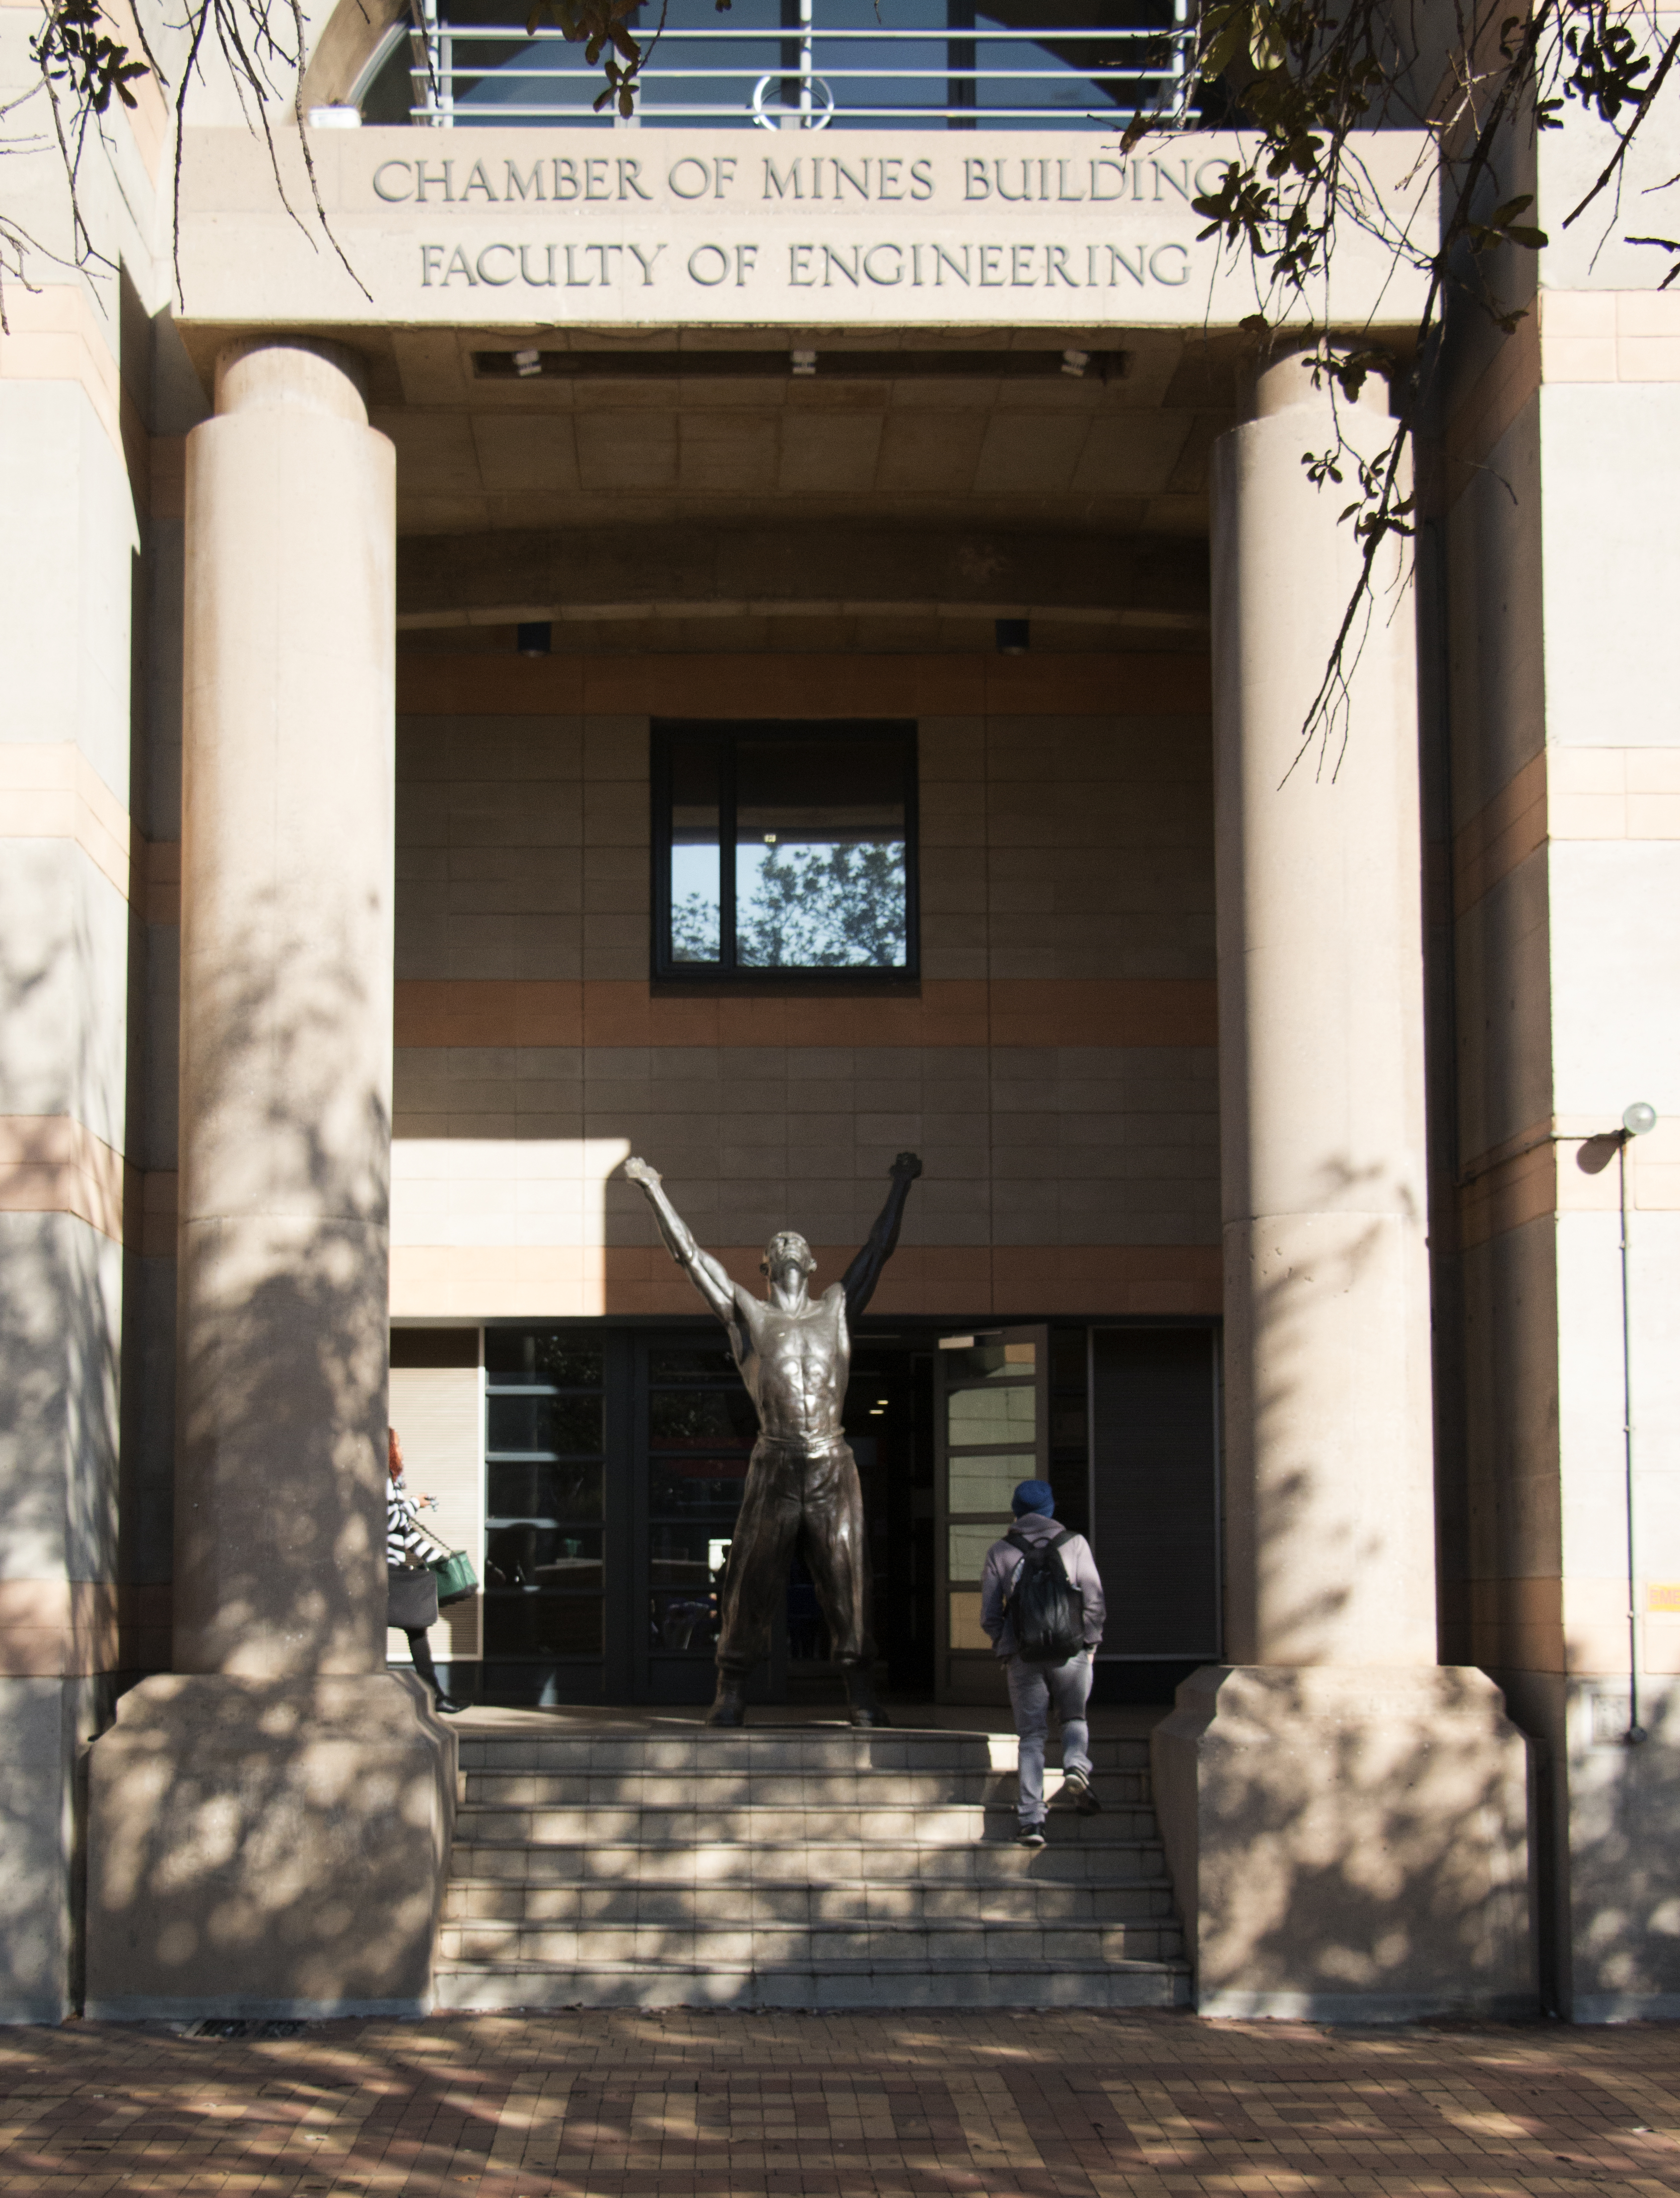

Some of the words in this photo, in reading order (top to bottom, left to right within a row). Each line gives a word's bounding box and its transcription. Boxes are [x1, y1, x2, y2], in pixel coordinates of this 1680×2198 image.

[373, 158, 653, 202] CHAMBER
[668, 157, 737, 201] OF
[762, 157, 934, 201] MINES
[420, 244, 668, 287] FACULTY
[688, 244, 759, 287] OF
[788, 243, 1192, 287] ENGINEERING
